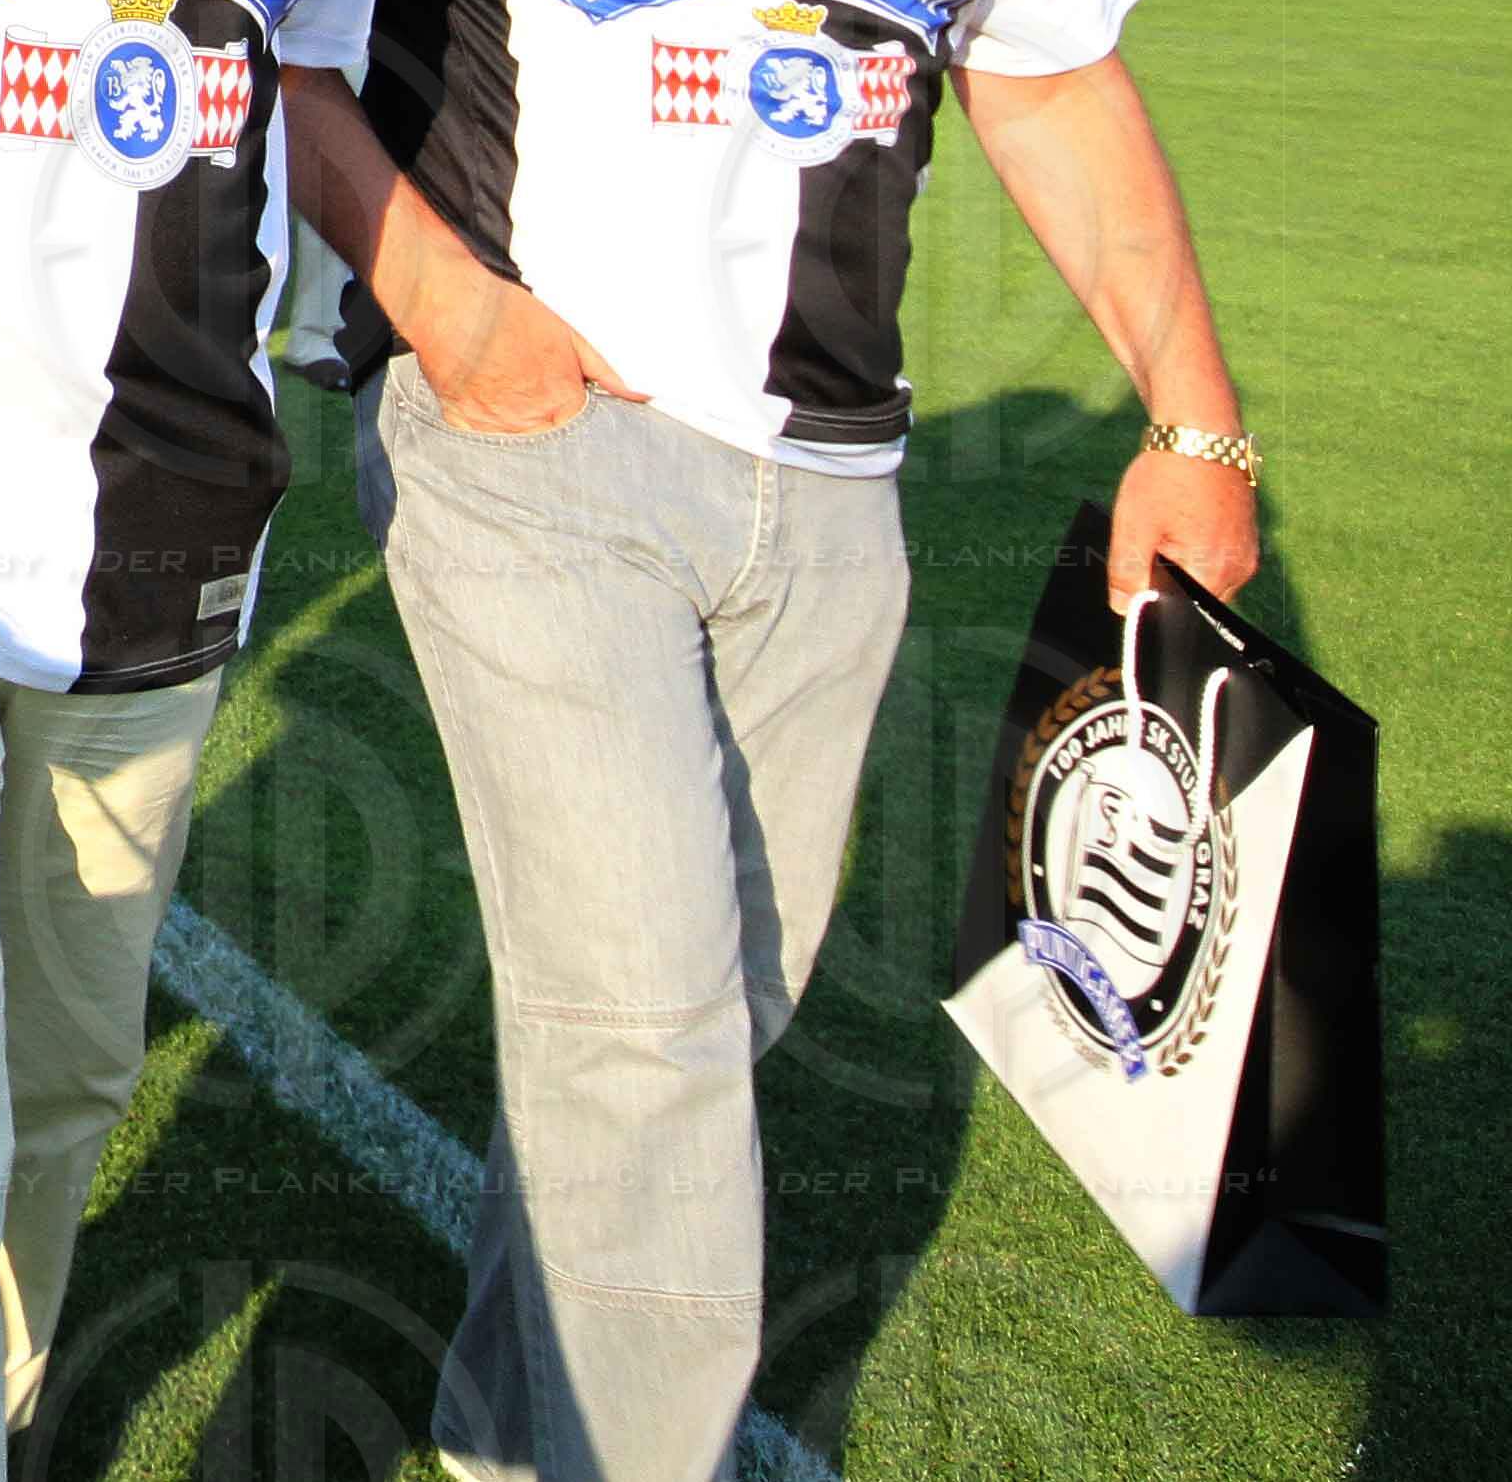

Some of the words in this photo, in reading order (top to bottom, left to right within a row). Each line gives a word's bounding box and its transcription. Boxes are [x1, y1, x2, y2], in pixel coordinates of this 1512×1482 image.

[1048, 737, 1083, 781] 100
[1084, 714, 1129, 749] JAH
[1145, 721, 1172, 753] SK
